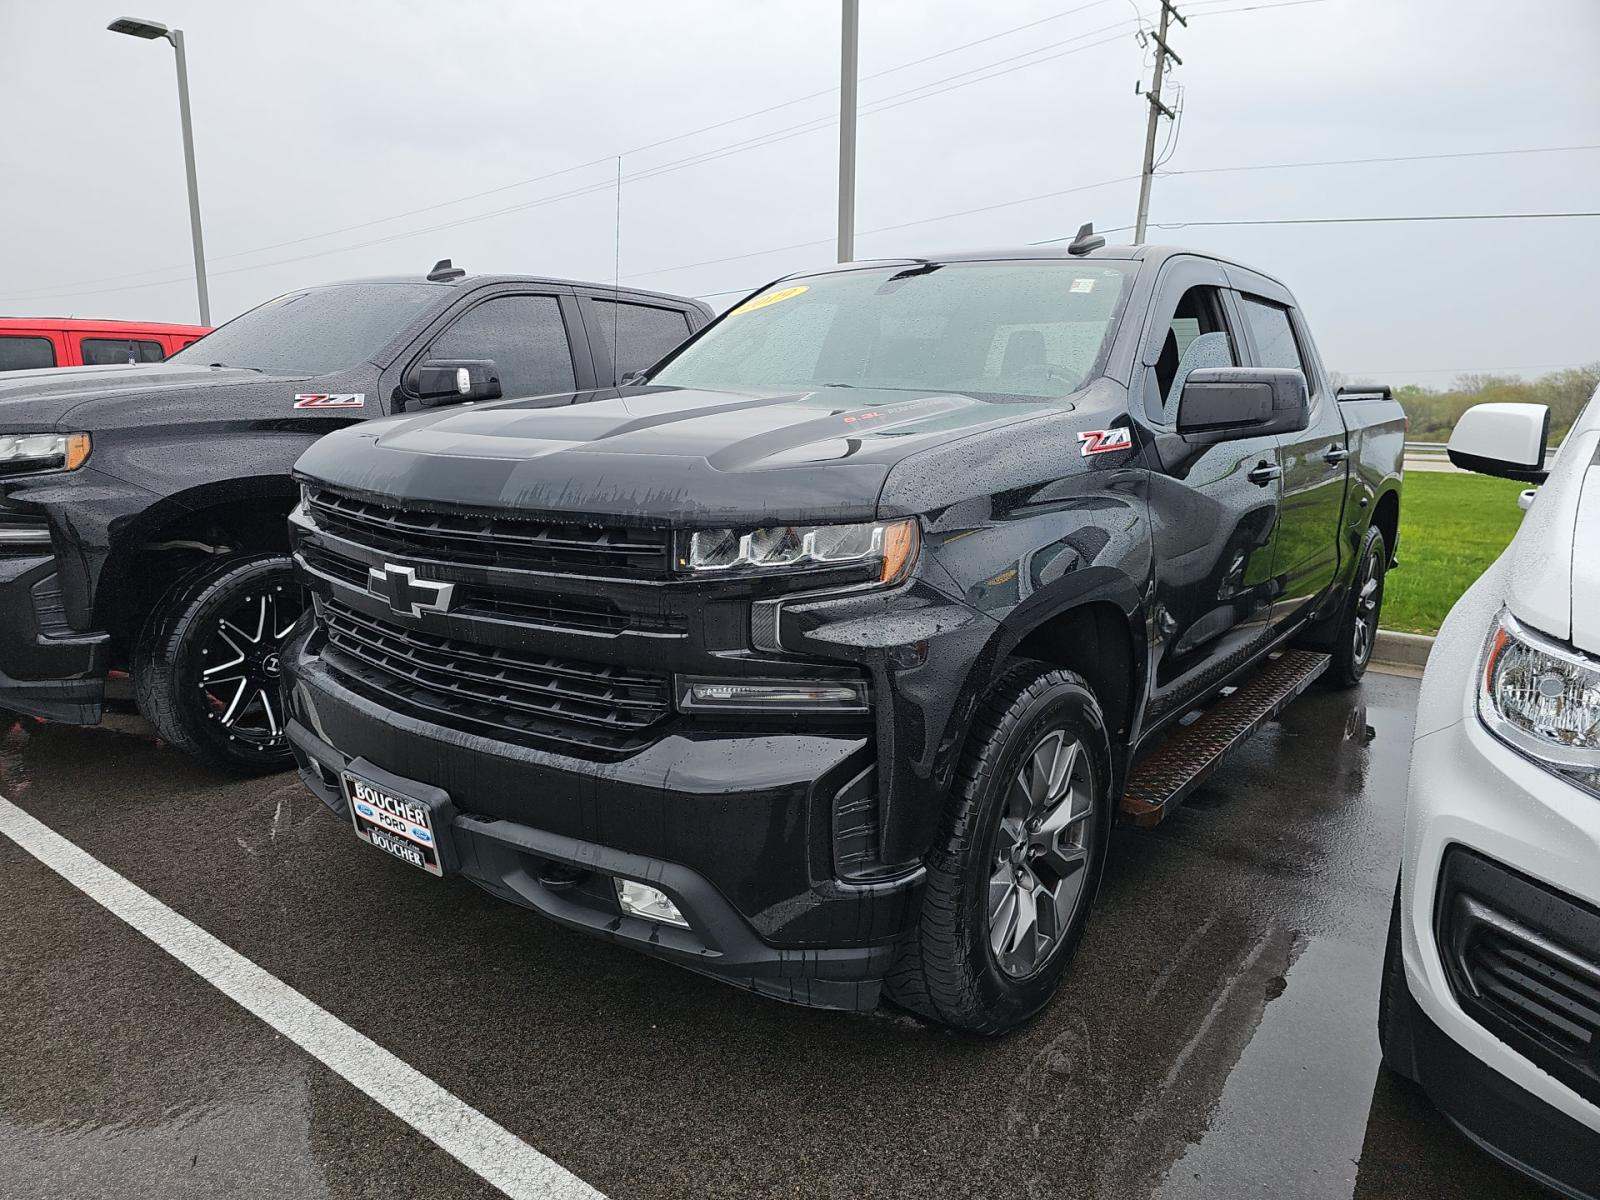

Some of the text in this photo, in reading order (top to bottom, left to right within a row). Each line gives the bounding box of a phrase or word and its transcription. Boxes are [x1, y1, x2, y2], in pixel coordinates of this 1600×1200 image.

[294, 393, 365, 409] Z71
[1077, 426, 1132, 456] Z71
[355, 781, 426, 827] BOUCHER
[379, 812, 406, 832] FORD
[372, 833, 422, 866] BOUCHER
